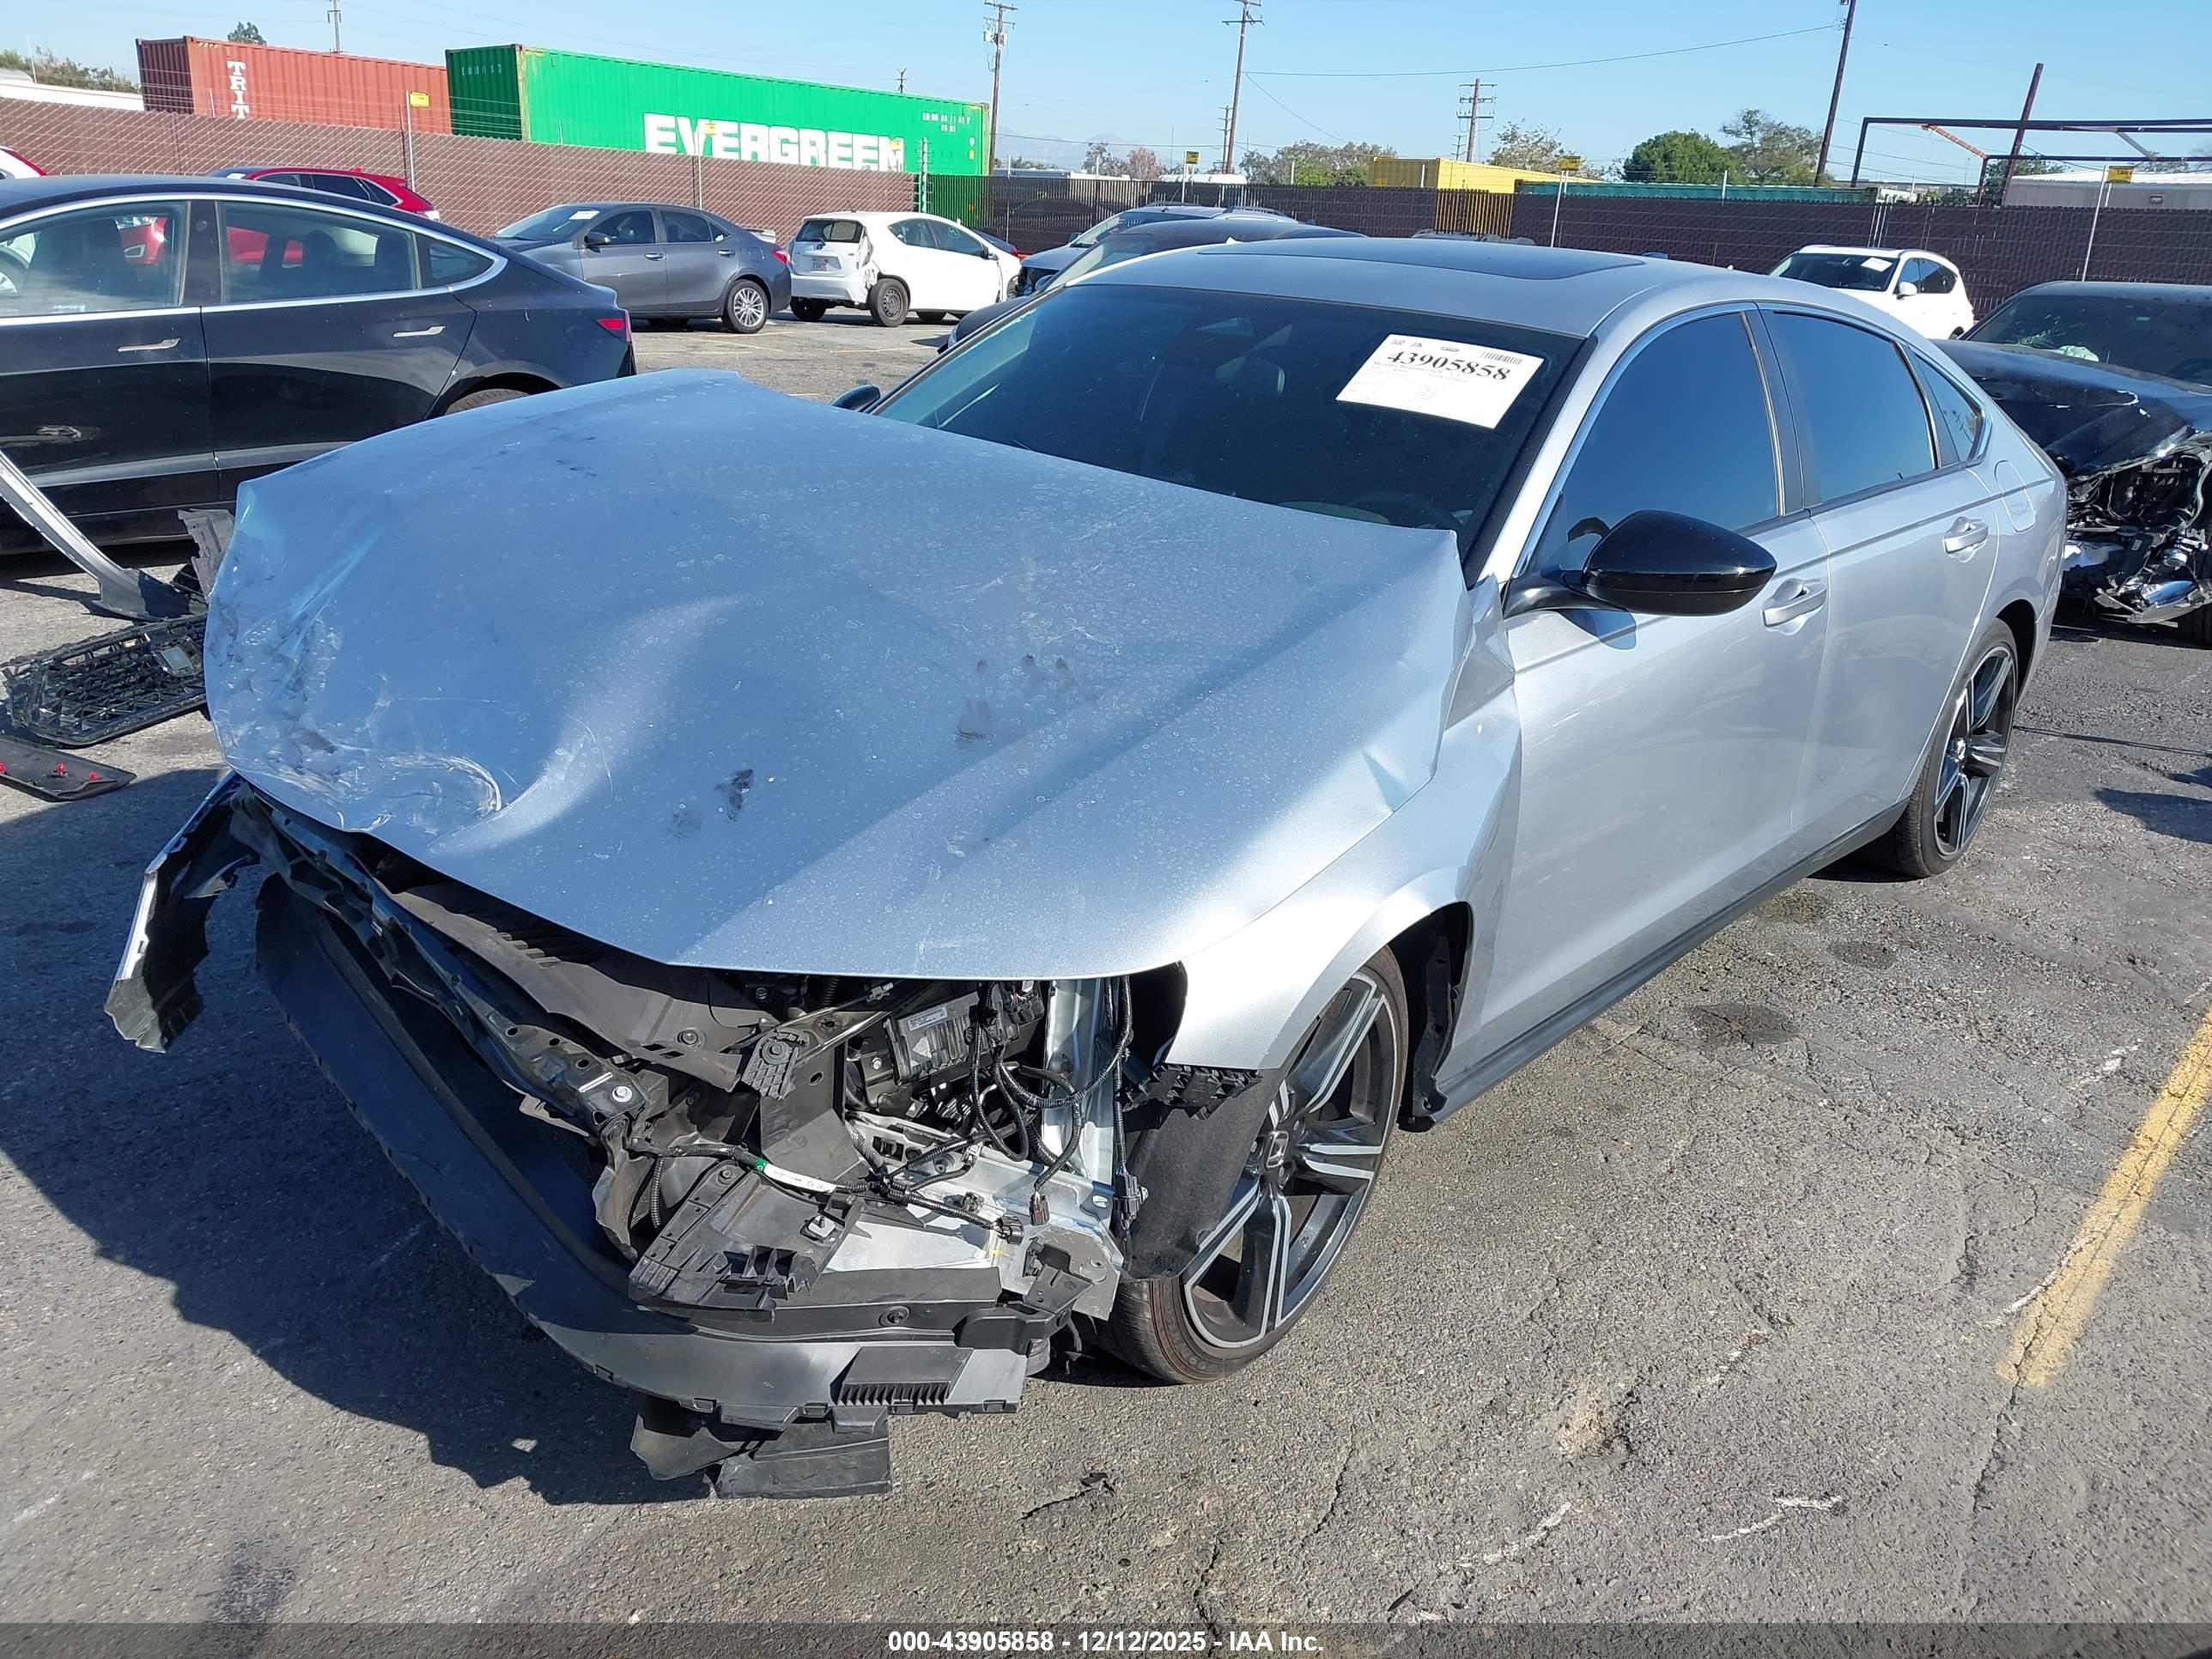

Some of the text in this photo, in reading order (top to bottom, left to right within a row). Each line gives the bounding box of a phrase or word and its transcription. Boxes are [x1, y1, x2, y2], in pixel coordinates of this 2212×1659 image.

[226, 60, 250, 119] TRIT
[643, 112, 904, 173] EVERGREEN
[1387, 350, 1511, 381] 43905858
